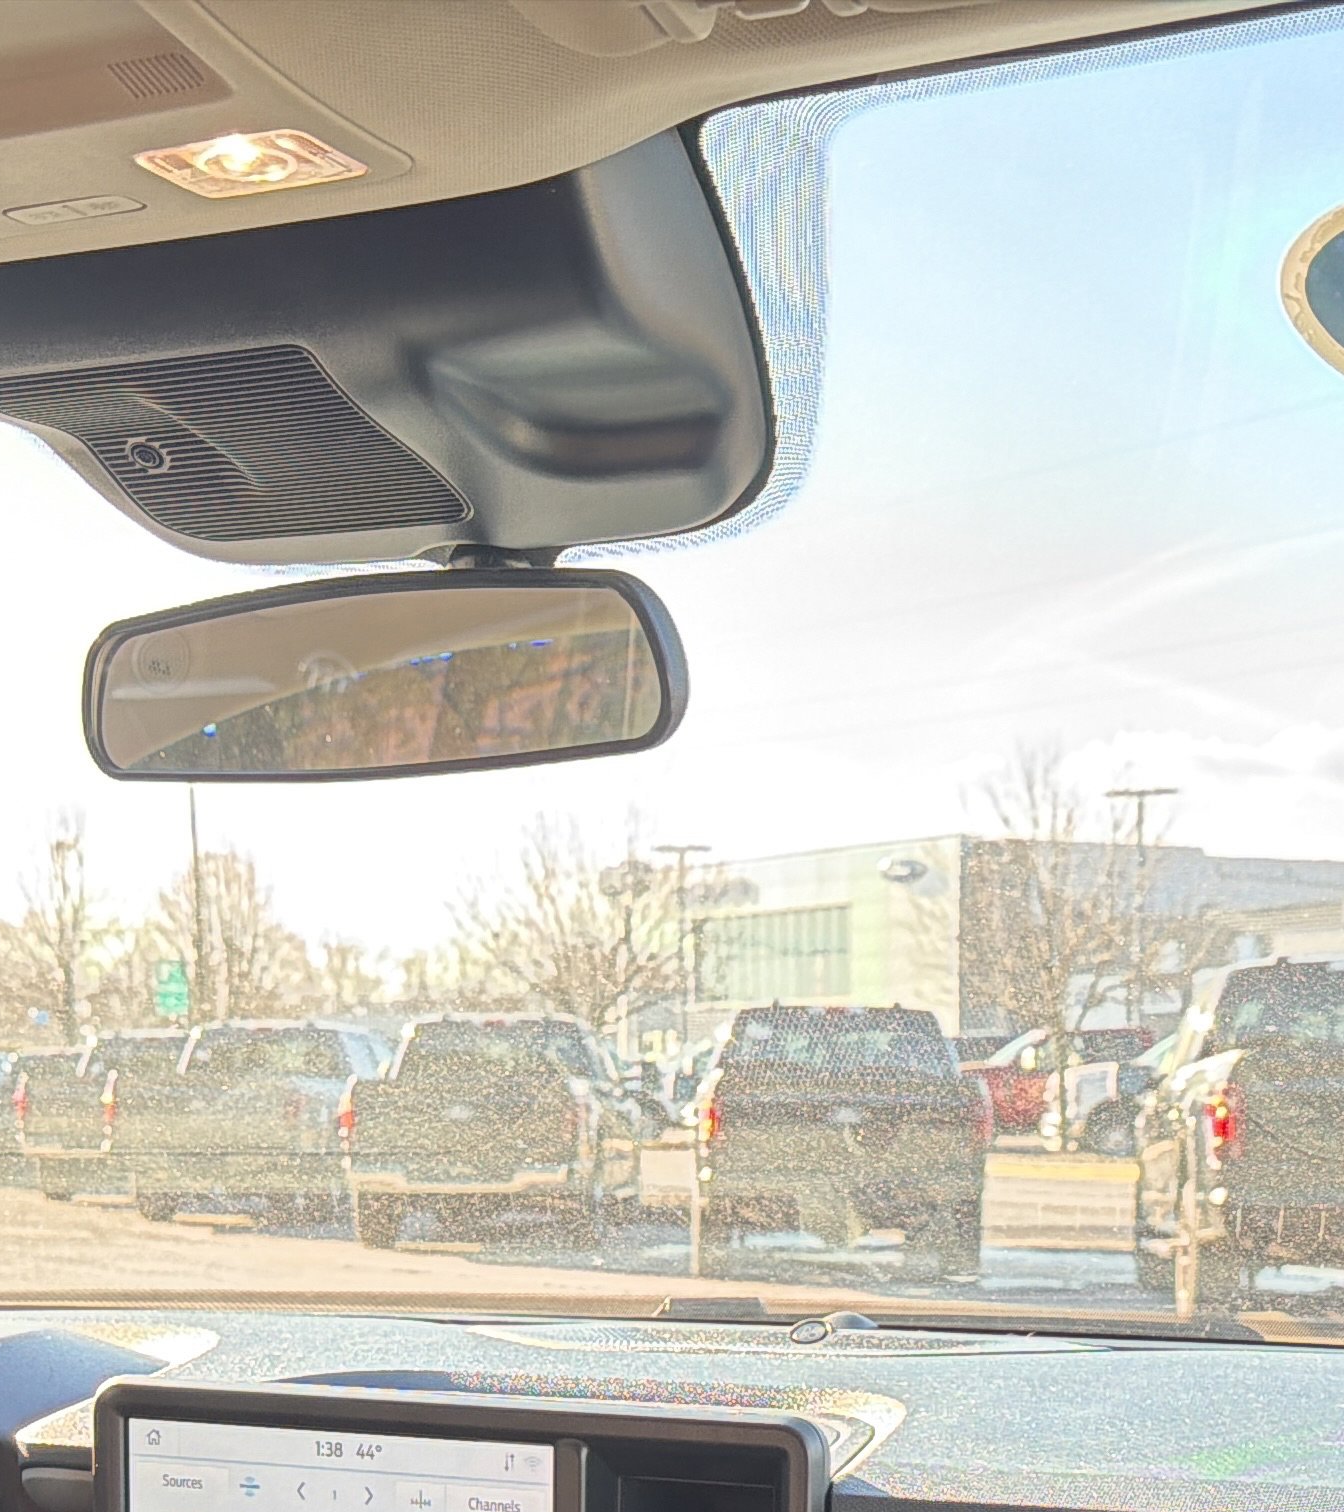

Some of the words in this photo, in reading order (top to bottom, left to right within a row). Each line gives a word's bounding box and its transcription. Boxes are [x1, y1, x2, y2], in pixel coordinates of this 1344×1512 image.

[315, 1440, 343, 1458] 1:38
[355, 1443, 383, 1460] 44°
[162, 1474, 204, 1490] Sources
